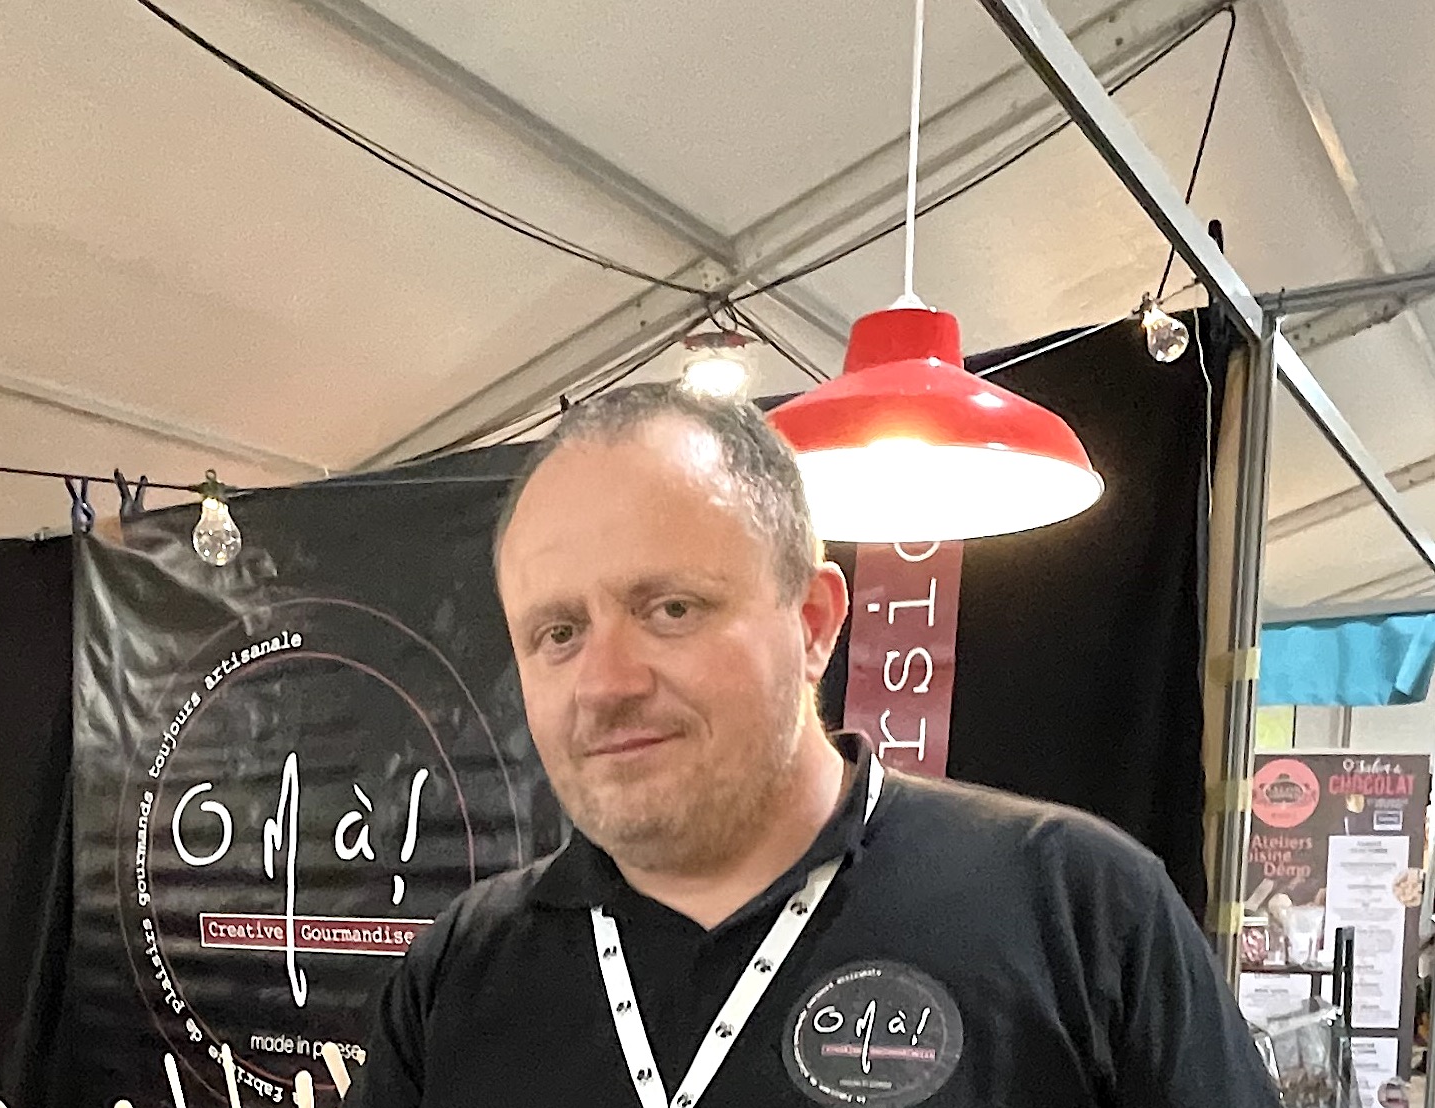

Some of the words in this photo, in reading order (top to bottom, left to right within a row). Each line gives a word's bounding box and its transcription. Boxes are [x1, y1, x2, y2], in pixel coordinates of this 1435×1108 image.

[204, 630, 303, 690] artisanale
[148, 691, 202, 779] toujours
[1328, 774, 1415, 796] CHOCOLAT
[135, 790, 154, 907] gourmands
[1251, 835, 1313, 851] Ateliers
[208, 921, 284, 940] Creative
[185, 1017, 203, 1043] de
[250, 1033, 295, 1054] made
[296, 1035, 310, 1055] in
[208, 1044, 284, 1103] fabrie
